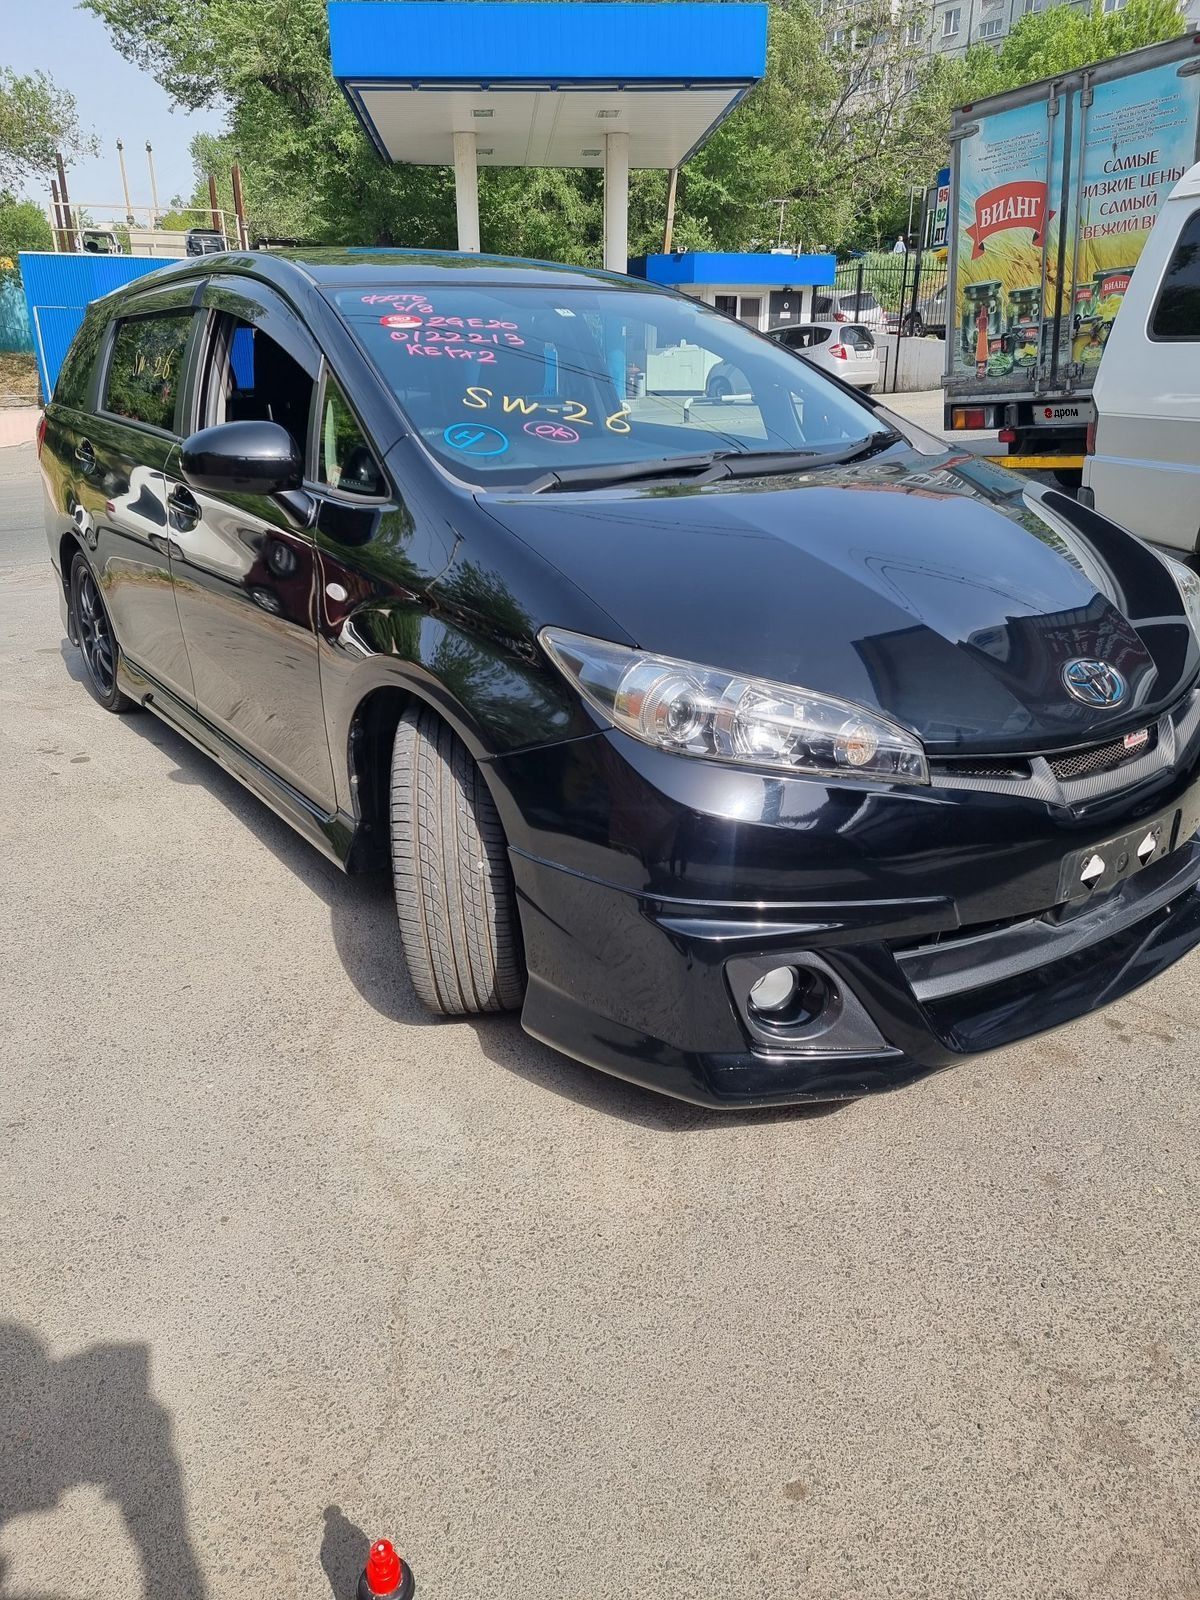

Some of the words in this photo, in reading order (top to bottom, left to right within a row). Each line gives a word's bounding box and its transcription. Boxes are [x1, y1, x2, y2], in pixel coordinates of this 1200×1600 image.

[1103, 149, 1160, 174] САМЫЕ
[1140, 166, 1186, 188] ЦЕНЫ
[938, 187, 949, 202] 95
[1100, 190, 1158, 216] САМЫЙ
[936, 207, 947, 222] 92
[980, 196, 1041, 228] ВИАНГ
[390, 331, 525, 345] 0122213
[535, 425, 574, 439] OK
